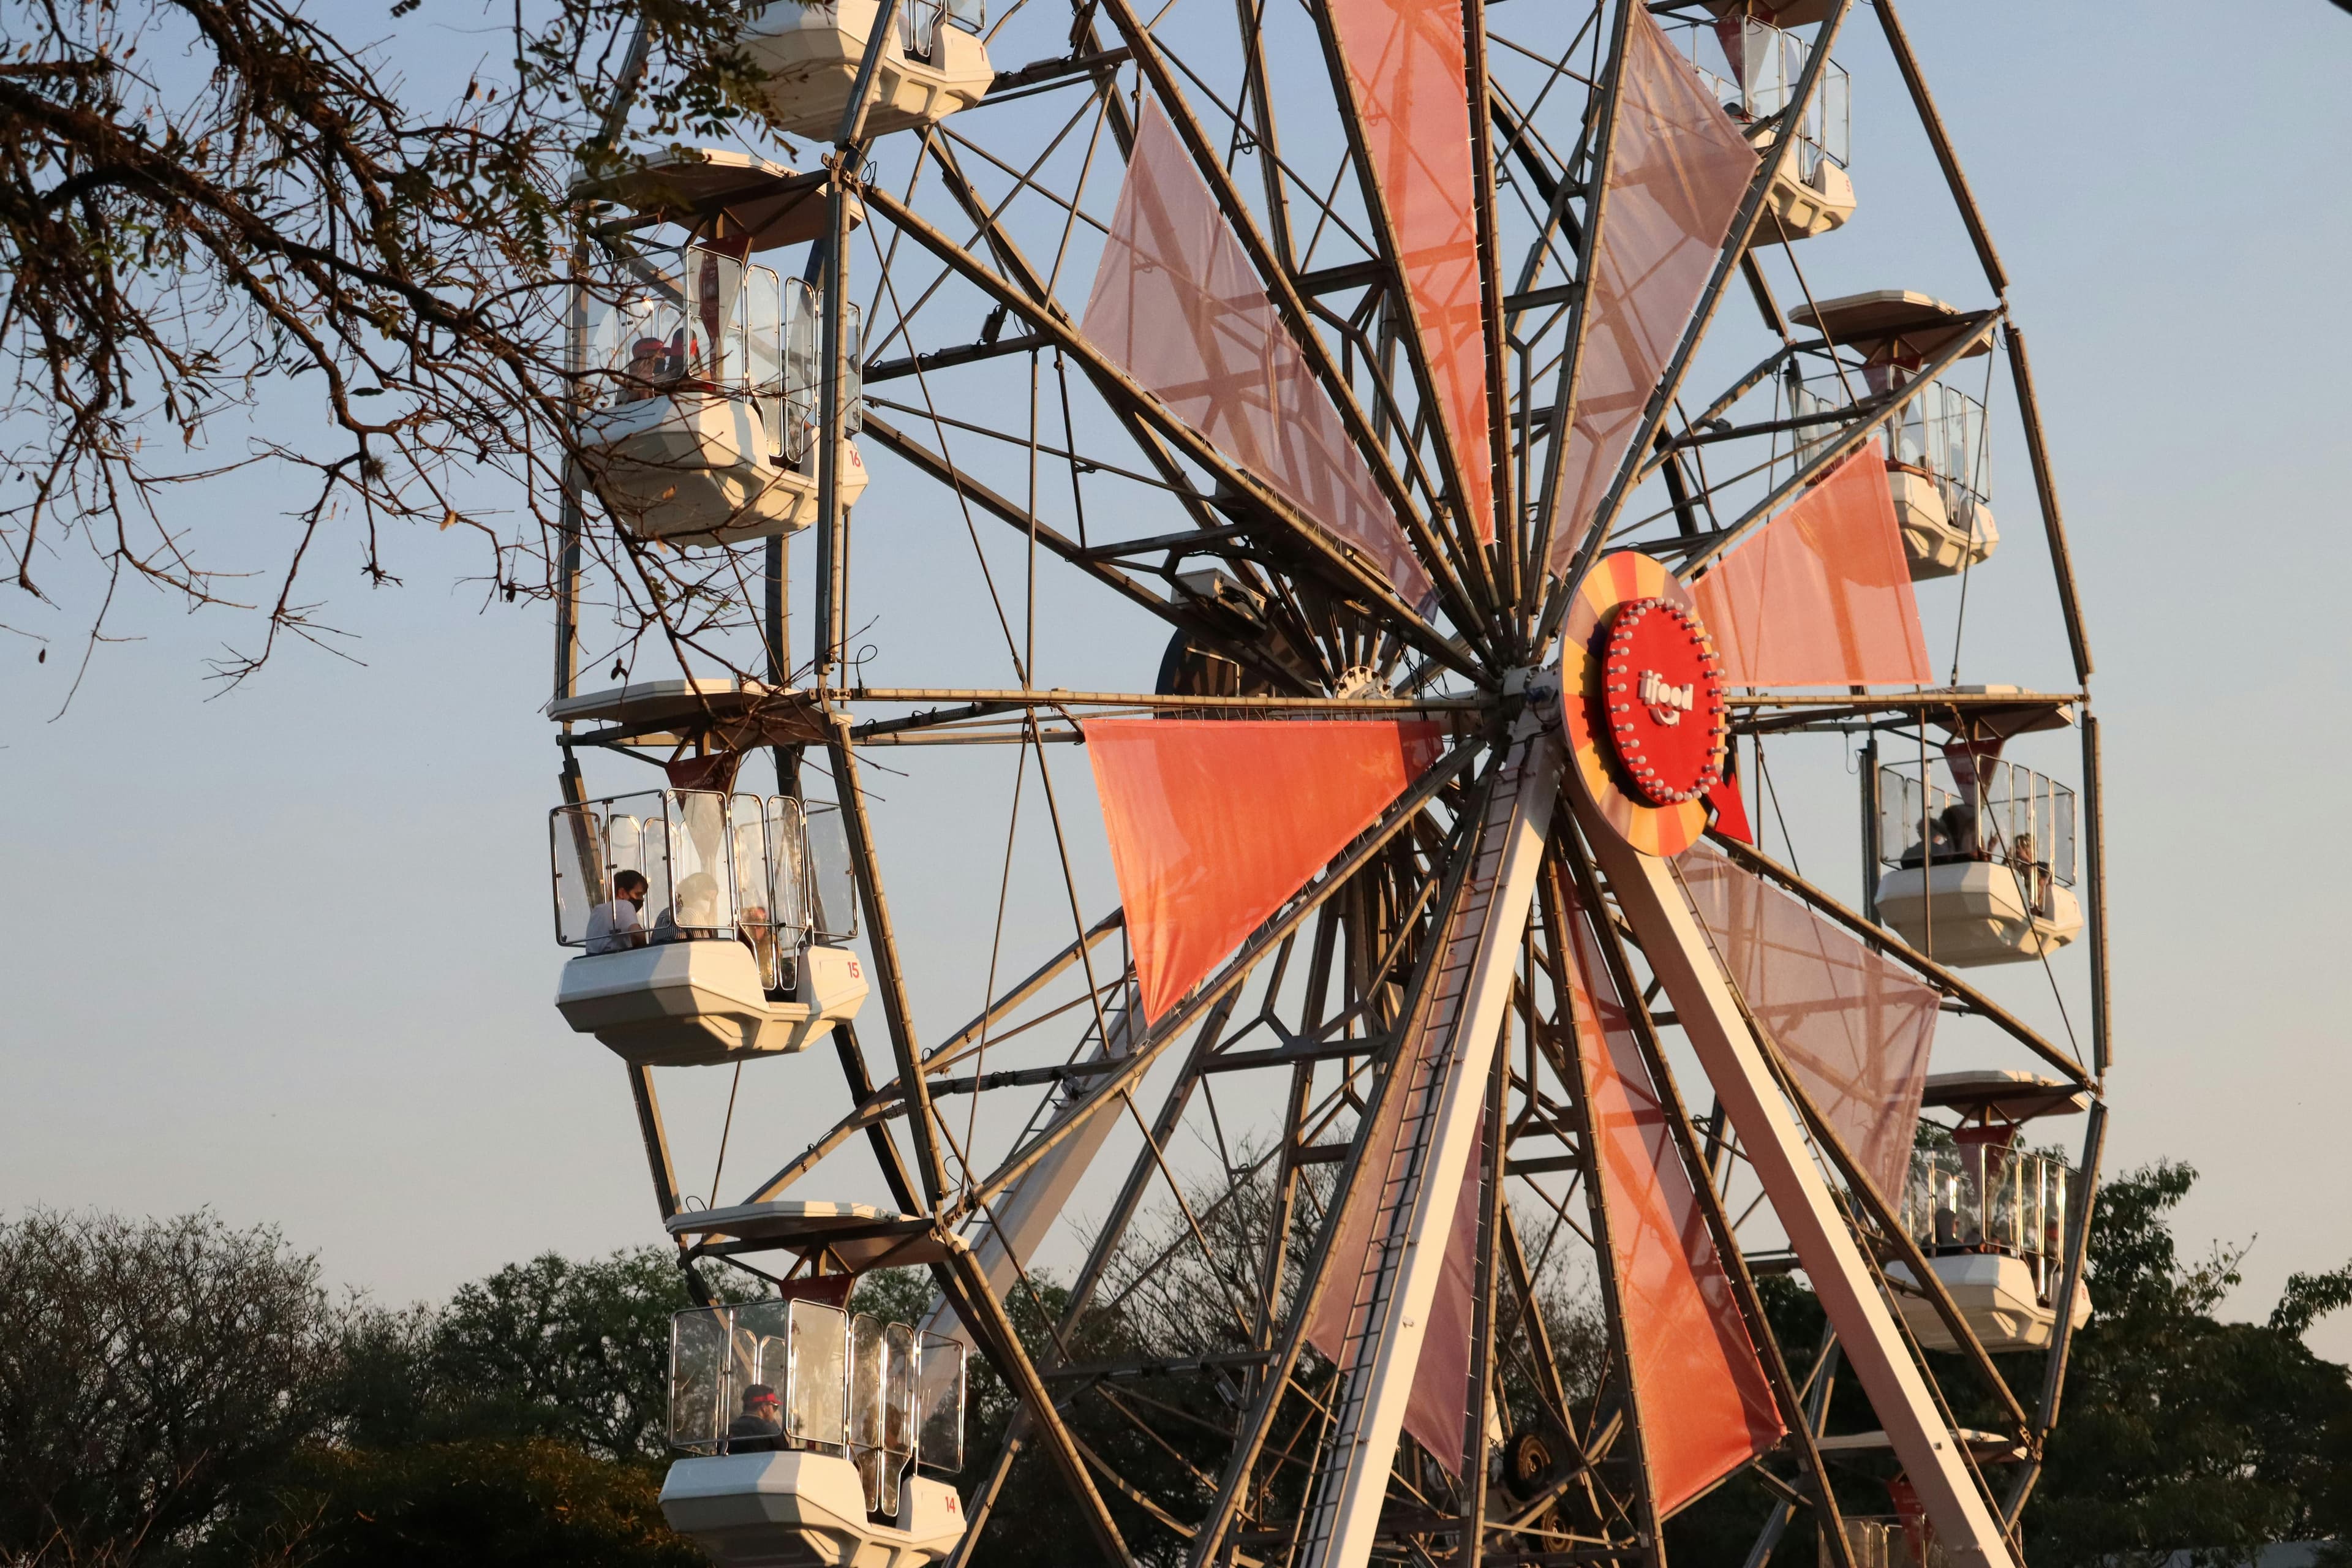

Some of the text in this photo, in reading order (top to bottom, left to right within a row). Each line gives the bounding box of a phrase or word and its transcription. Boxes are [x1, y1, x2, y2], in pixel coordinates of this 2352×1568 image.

[850, 450, 861, 467] 16
[1642, 669, 1694, 711] ifood
[847, 962, 859, 979] 15
[945, 1496, 956, 1513] 14
